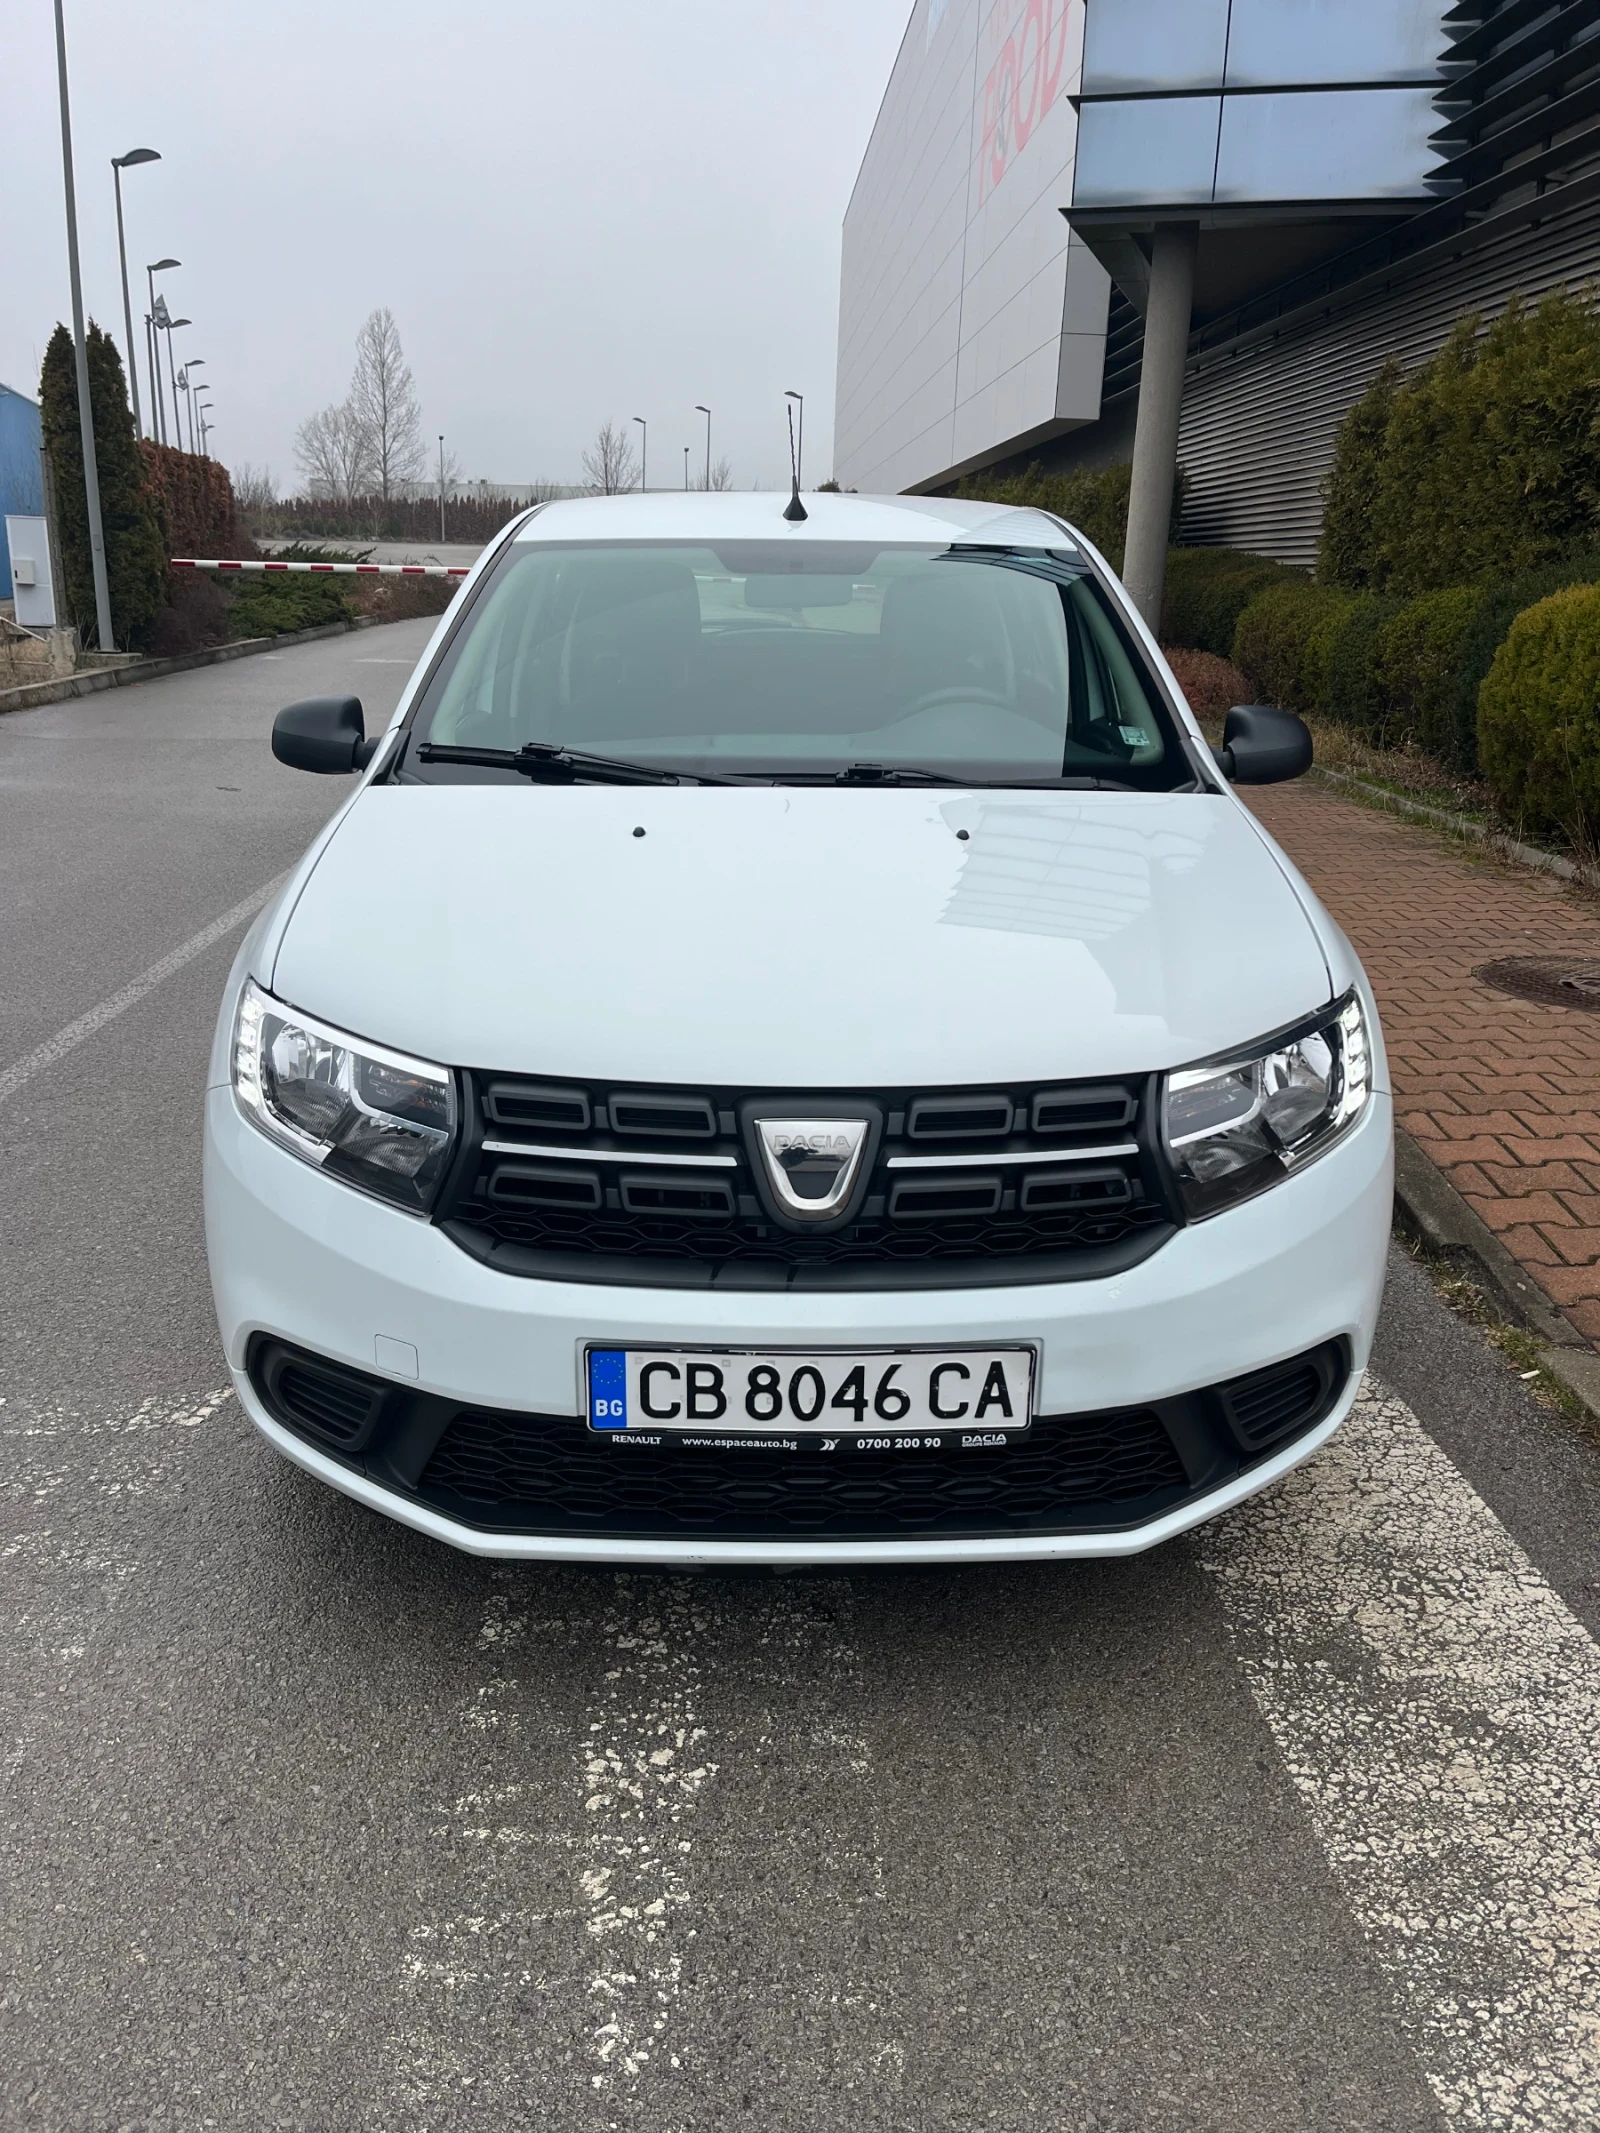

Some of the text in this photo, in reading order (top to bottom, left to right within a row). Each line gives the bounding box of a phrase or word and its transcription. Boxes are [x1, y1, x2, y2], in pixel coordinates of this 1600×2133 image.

[774, 1135, 851, 1149] DACIA
[639, 1360, 1013, 1422] CB 8046 CA
[595, 1399, 623, 1417] BG
[612, 1434, 662, 1445] RENAULT
[682, 1437, 798, 1450] www.espaceauto.bg
[857, 1437, 941, 1449] 0700 200 90
[961, 1433, 1007, 1443] DACIA
